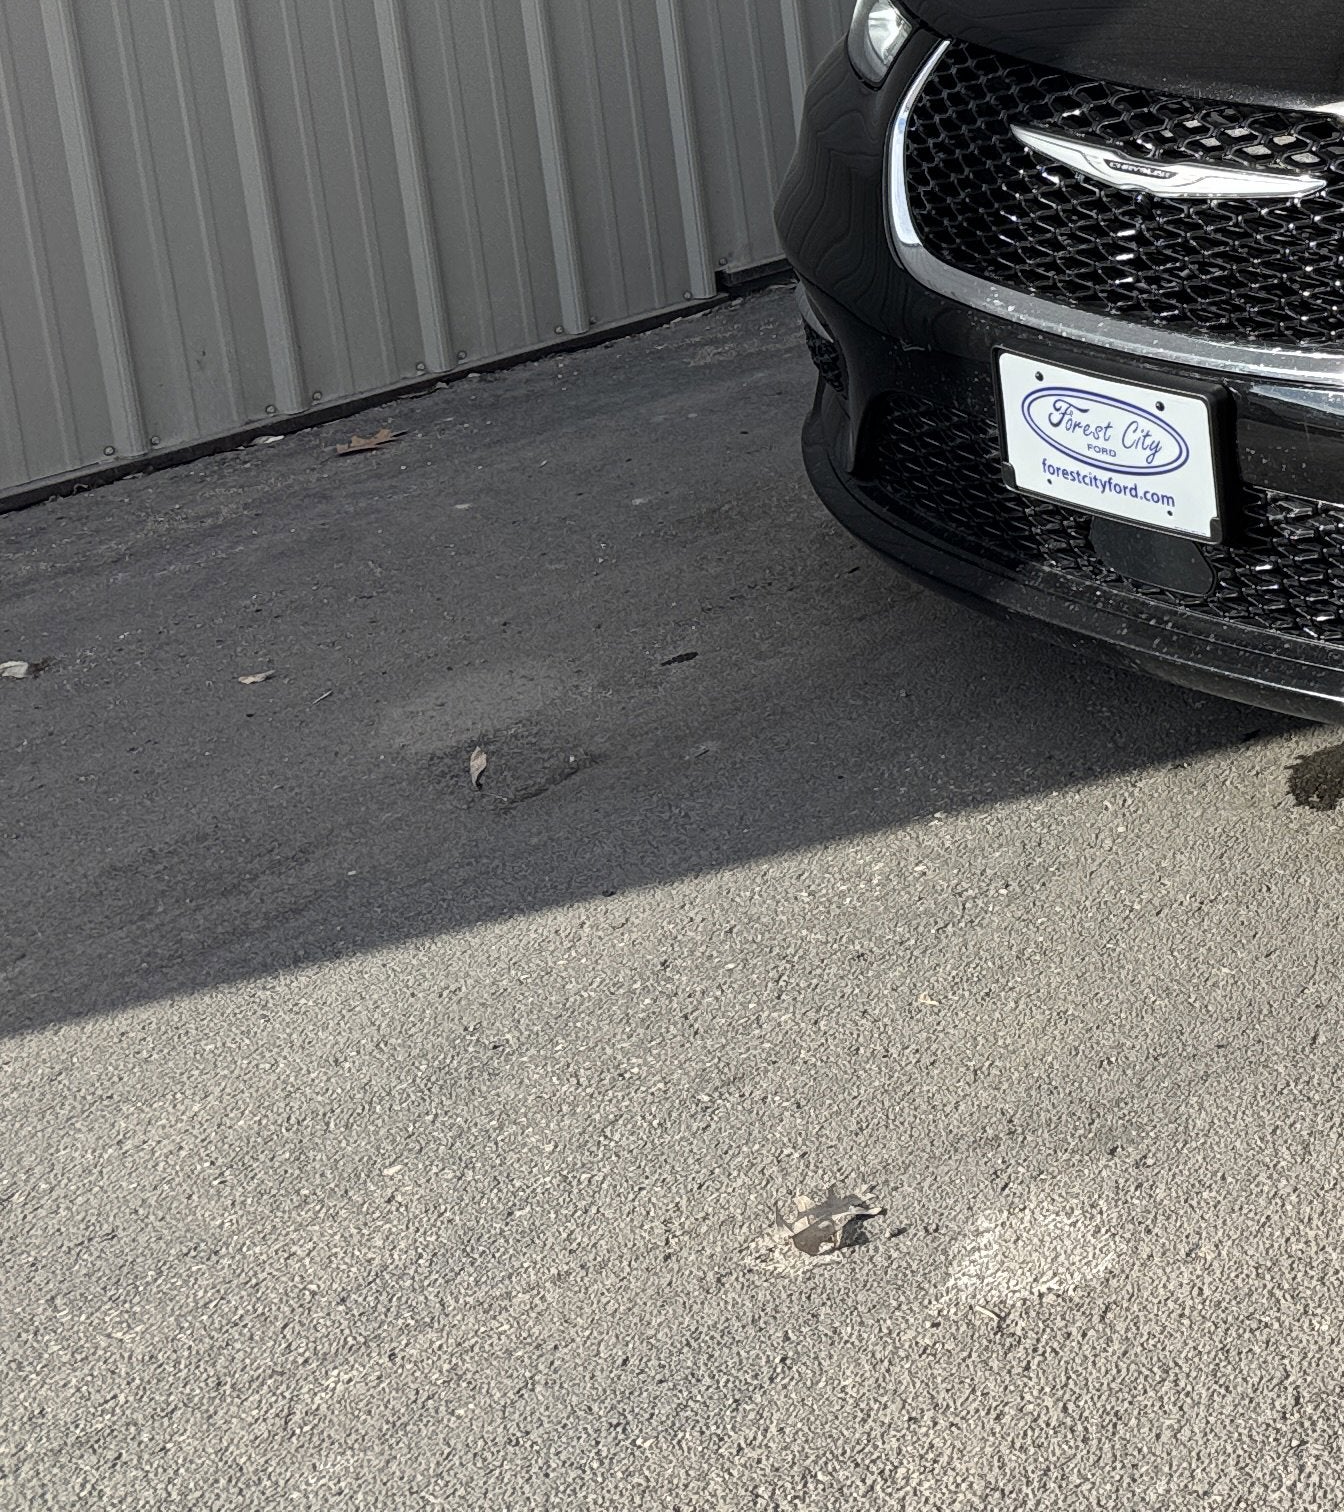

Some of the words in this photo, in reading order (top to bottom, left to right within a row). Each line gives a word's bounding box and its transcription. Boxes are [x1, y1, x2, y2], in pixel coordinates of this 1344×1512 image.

[1048, 398, 1113, 442] Forest
[1121, 420, 1163, 465] City
[1087, 443, 1117, 458] FORD
[1041, 457, 1176, 508] forestcityford.com
